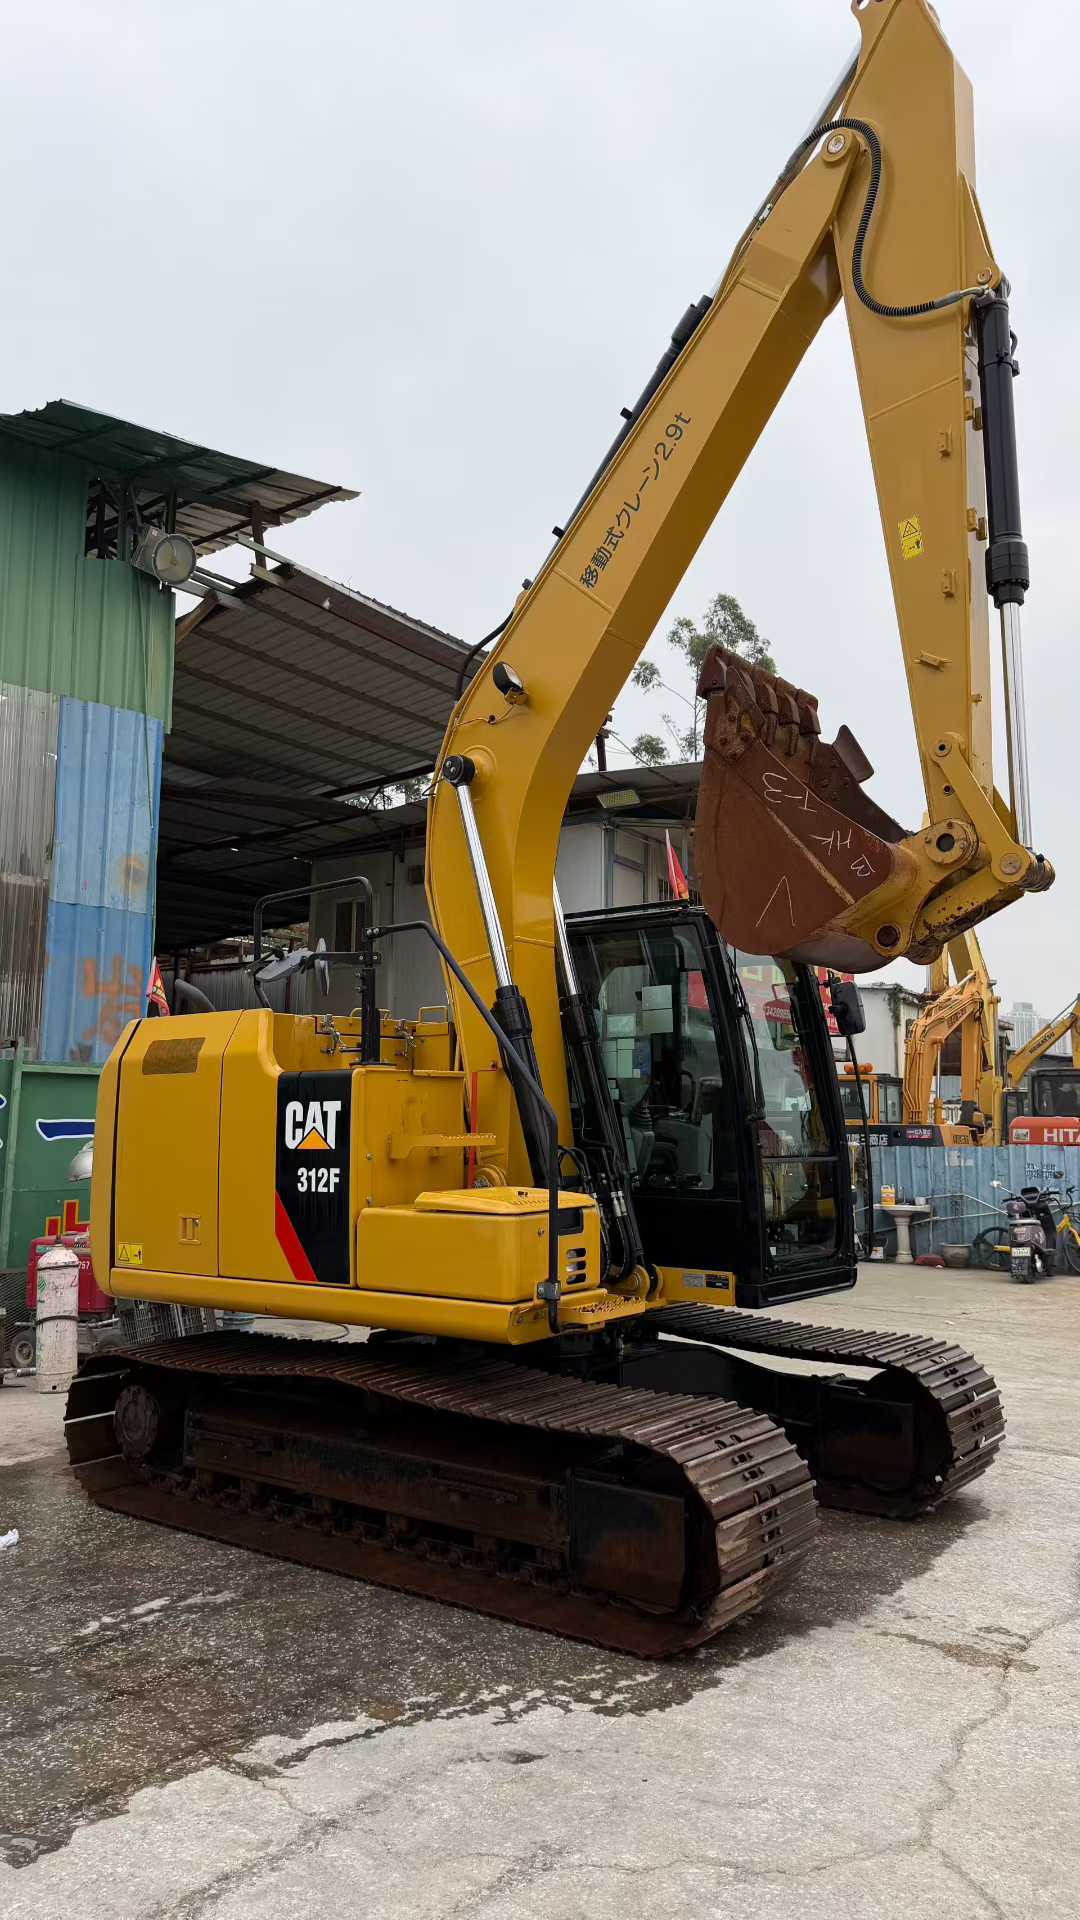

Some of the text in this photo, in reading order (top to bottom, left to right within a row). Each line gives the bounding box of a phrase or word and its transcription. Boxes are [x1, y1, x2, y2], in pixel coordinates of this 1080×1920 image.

[579, 411, 692, 589] 移動式クレーン2.9t
[284, 1100, 342, 1150] CAT
[297, 1167, 341, 1193] 312F
